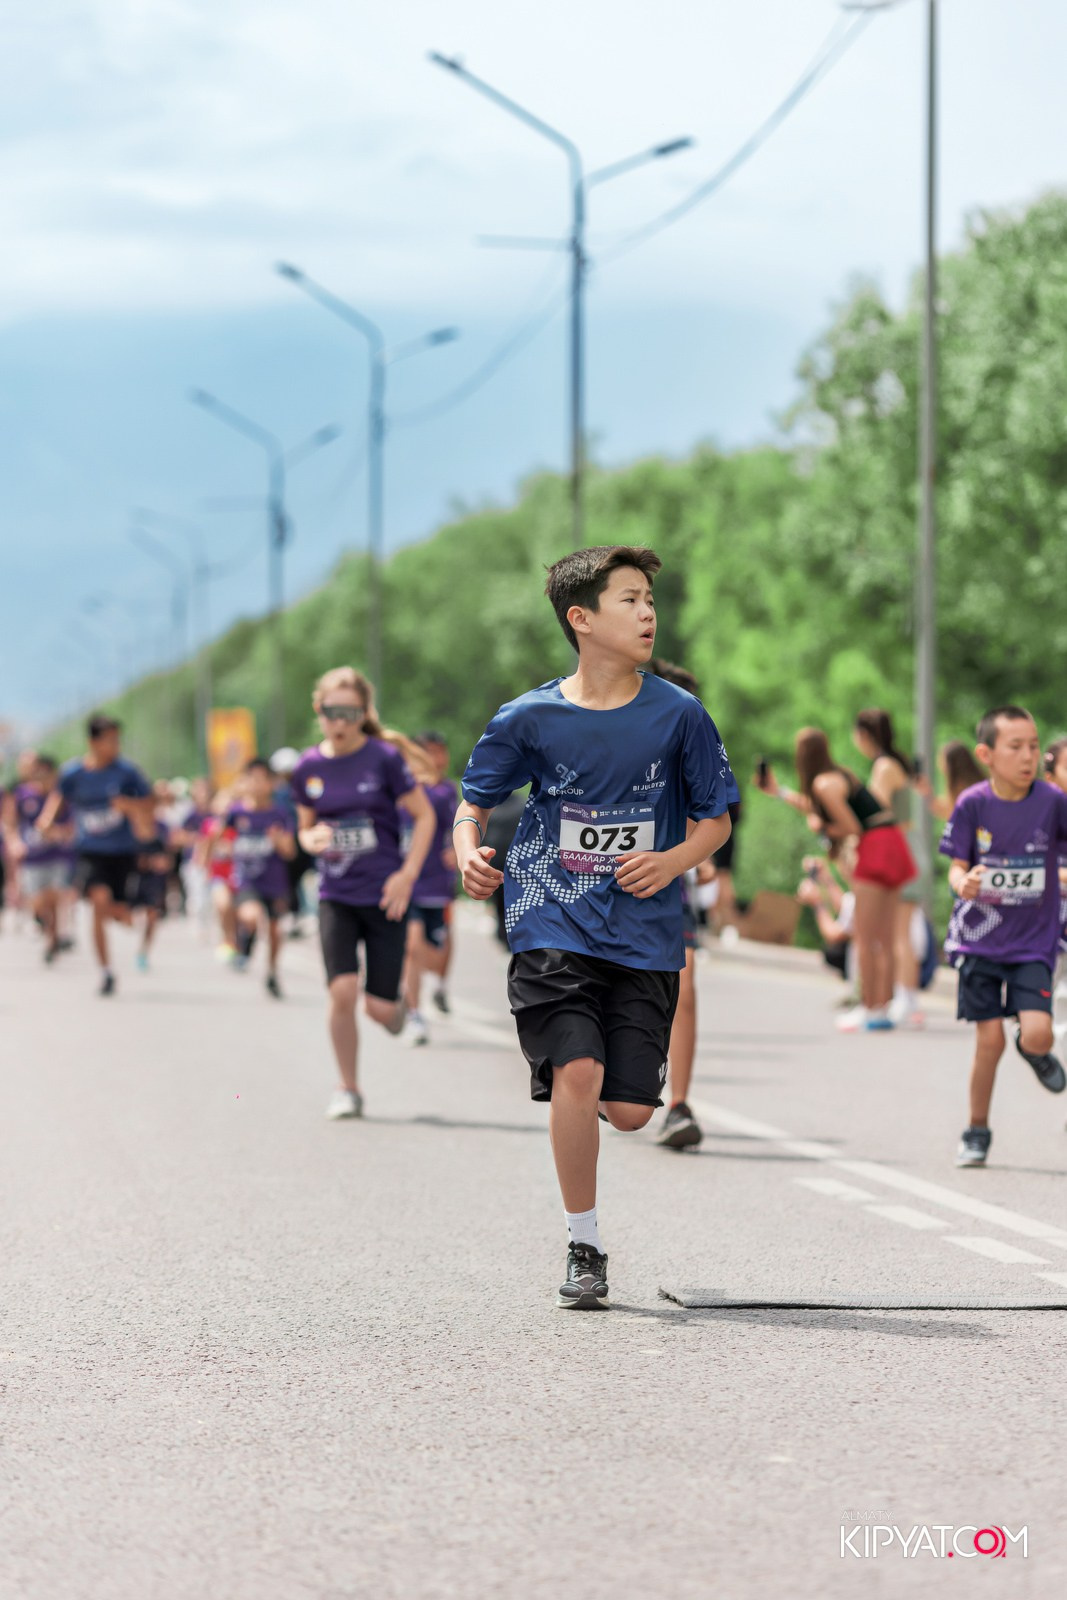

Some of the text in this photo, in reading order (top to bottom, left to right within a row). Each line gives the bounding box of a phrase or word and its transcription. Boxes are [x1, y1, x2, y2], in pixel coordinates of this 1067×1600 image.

[579, 826, 639, 852] 073
[563, 852, 619, 864] БАЛАЛАР Ж
[593, 864, 612, 872] 600
[991, 872, 1033, 889] 034
